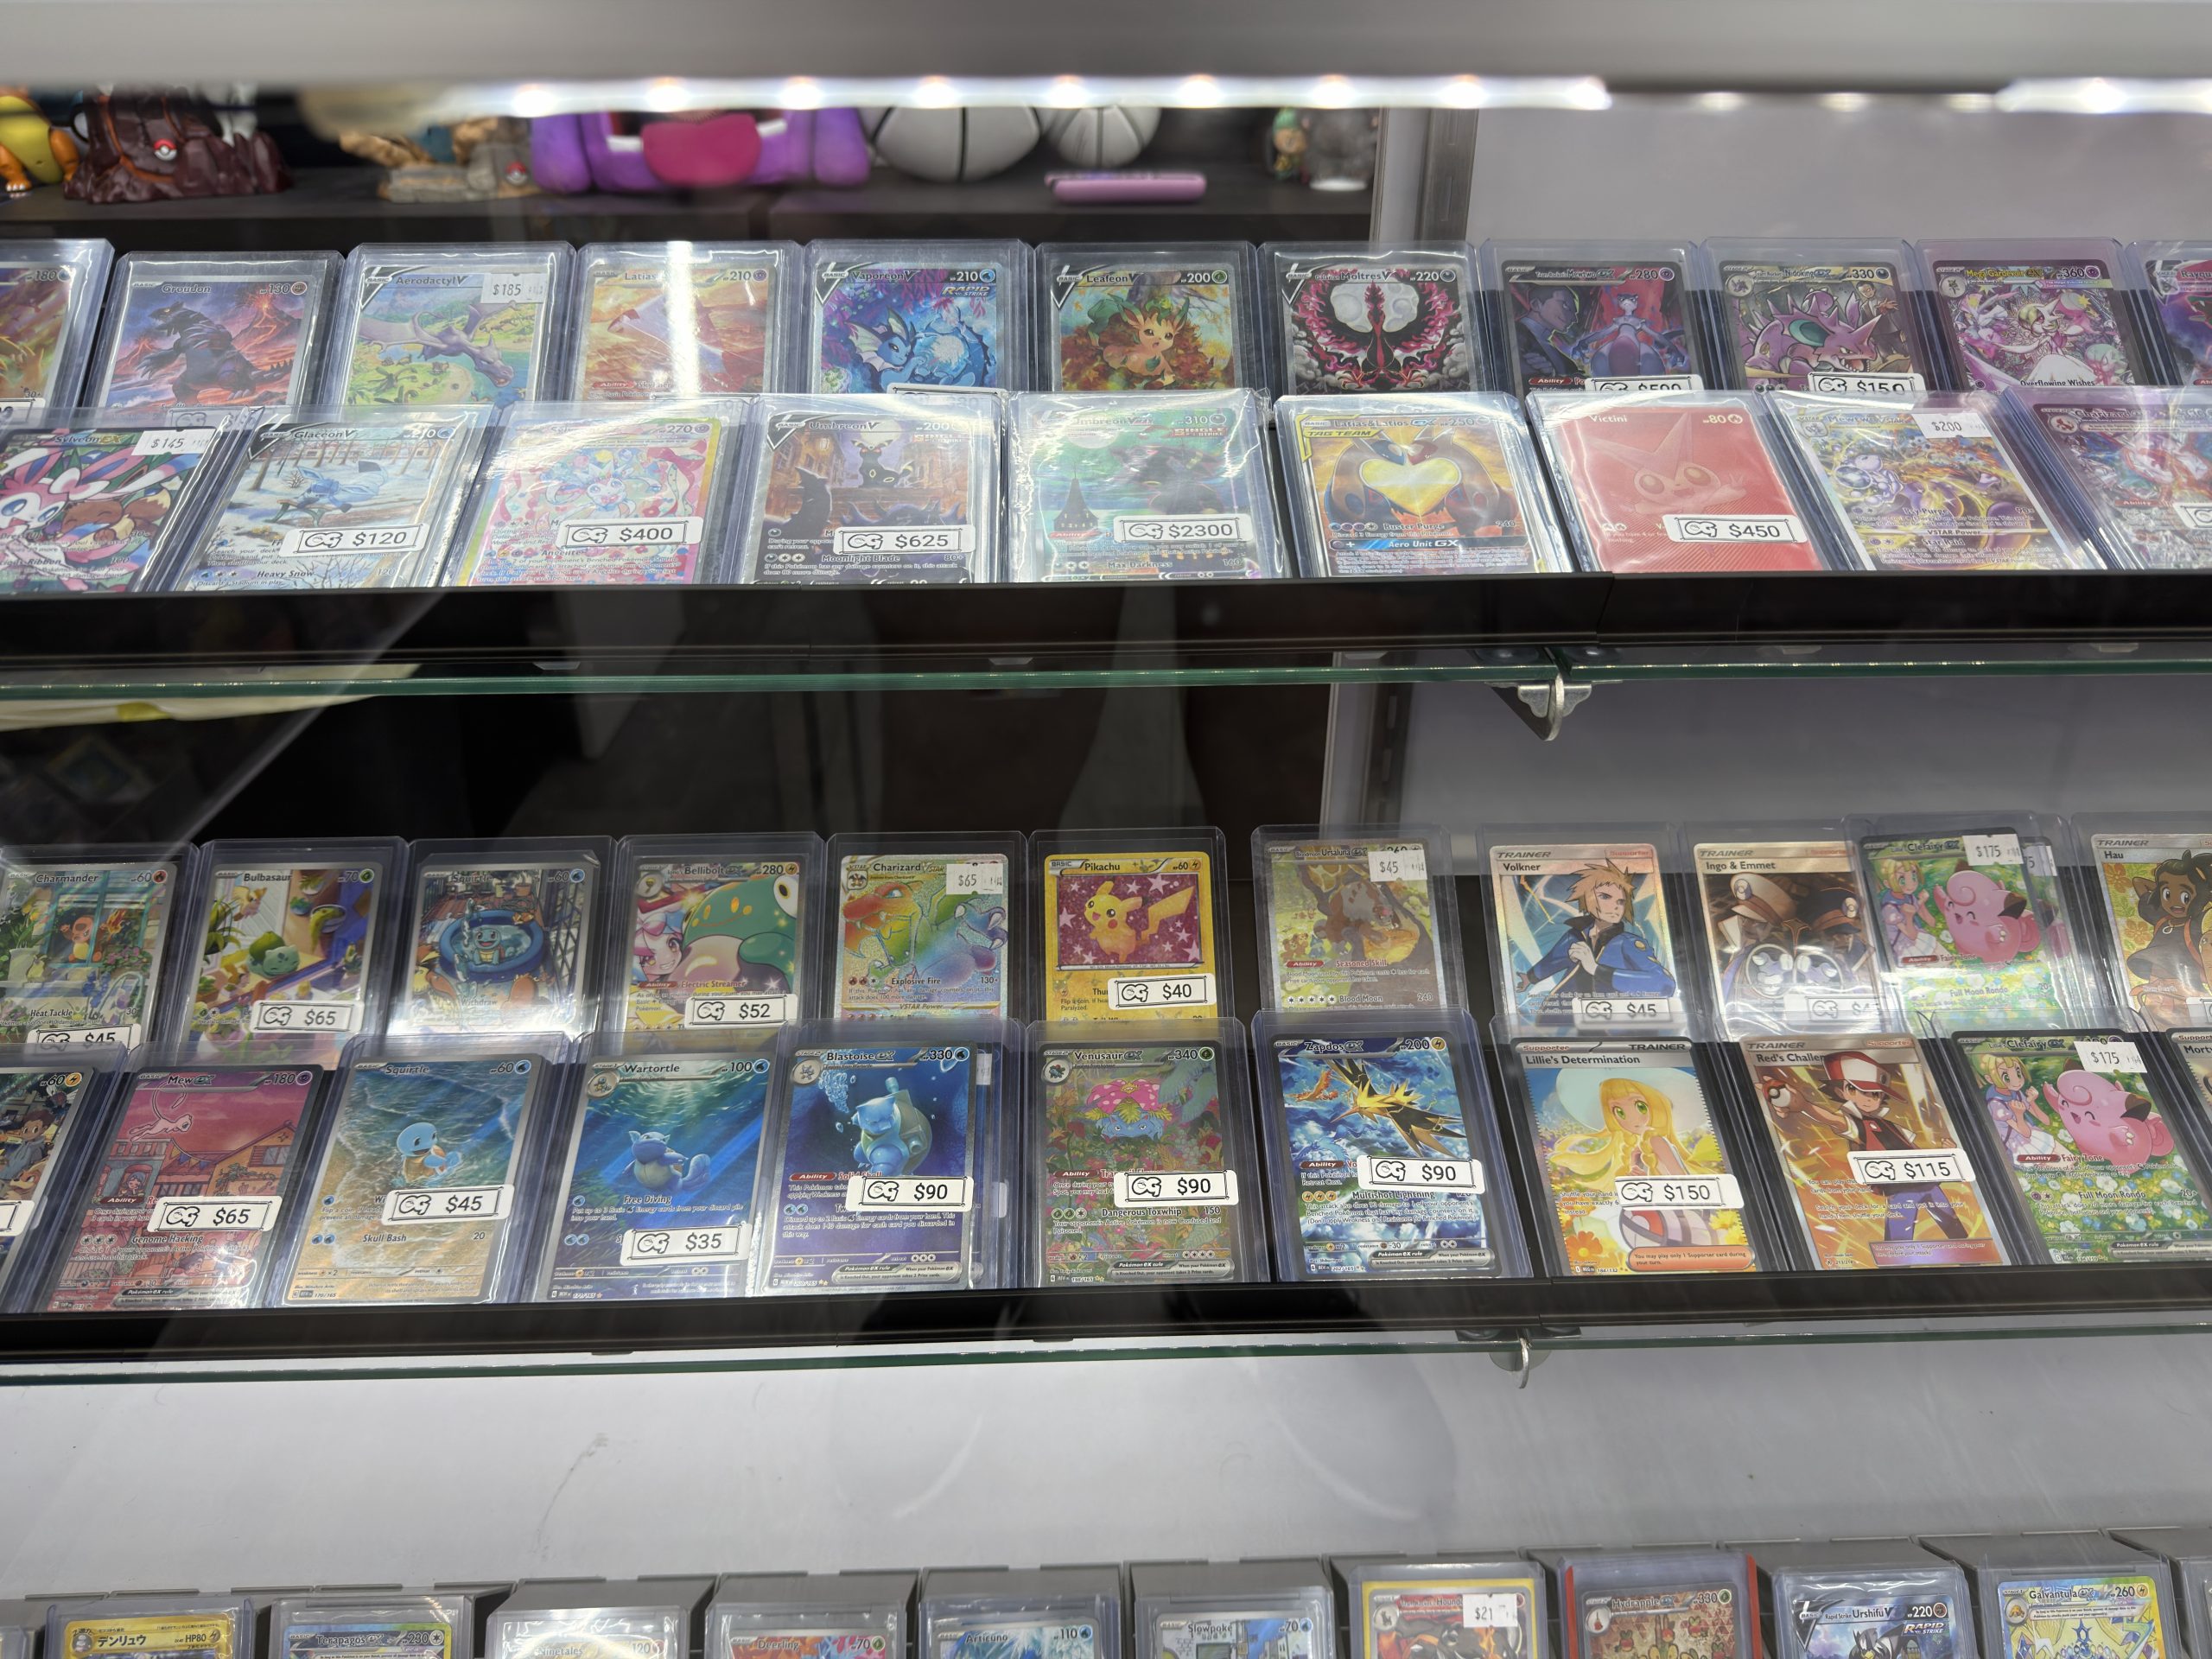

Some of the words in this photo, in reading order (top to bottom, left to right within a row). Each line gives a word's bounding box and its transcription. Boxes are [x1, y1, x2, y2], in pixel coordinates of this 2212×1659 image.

[730, 270, 752, 282] 210
[851, 270, 905, 282] Vaporeon
[957, 271, 978, 282] 210
[1187, 273, 1211, 283] 200
[1340, 271, 1382, 281] Moltres
[1415, 271, 1439, 281] 220
[1637, 270, 1657, 279] 280
[1853, 270, 1874, 279] 330
[2063, 268, 2085, 278] 360
[1086, 274, 1128, 283] Leafeon
[162, 284, 211, 294] Groudon
[269, 283, 290, 294] 130
[493, 283, 522, 296] $185
[1185, 416, 1207, 424] 310
[667, 424, 692, 434] 270
[923, 422, 949, 431] 200
[1931, 422, 1962, 433] $200
[150, 437, 184, 448] $145
[1169, 524, 1233, 538] $2300
[1417, 523, 1445, 531] Purge
[1729, 523, 1780, 538] $450
[353, 532, 407, 547] $120
[619, 527, 673, 542] $400
[895, 534, 949, 549] $625
[822, 554, 871, 563] Moonlight
[1321, 849, 1351, 857] Ursaluna
[1976, 846, 2001, 858] $175
[684, 866, 724, 875] Bellibolt
[763, 865, 783, 874] 280
[873, 863, 921, 872] Charizard
[1084, 862, 1120, 872] Pikachu
[1379, 861, 1399, 874] $45
[1707, 861, 1727, 872] Ingo
[1730, 861, 1738, 870] &
[35, 874, 99, 883] Charmander
[137, 873, 151, 882] 60
[244, 874, 292, 882] Bulbasaur
[555, 873, 569, 881] 60
[958, 874, 977, 887] $65
[892, 977, 925, 986] Explosive
[1162, 983, 1192, 1001] $40
[739, 1002, 771, 1019] $52
[1627, 1002, 1656, 1018] $45
[304, 1010, 336, 1026] $65
[1304, 1041, 1344, 1052] Zapdos
[1406, 1039, 1430, 1051] 200
[2006, 1039, 2047, 1050] Clefairy
[826, 1052, 874, 1061] Blastoise
[929, 1050, 953, 1060] 330
[1075, 1052, 1123, 1061] Venusaur
[1175, 1050, 1198, 1059] 340
[1756, 1053, 1785, 1063] Red's
[2090, 1052, 2120, 1065] $175
[1525, 1056, 1559, 1065] Lillie's
[1561, 1056, 1641, 1065] Determination
[385, 1065, 429, 1075] Squirtle
[498, 1063, 513, 1073] 60
[624, 1064, 680, 1074] Wartortle
[730, 1062, 752, 1073] 100
[48, 1075, 65, 1086] 60
[167, 1075, 194, 1085] Mew
[272, 1073, 296, 1084] 180
[2061, 1154, 2081, 1163] Fairy
[1421, 1164, 1456, 1182] $90
[1904, 1161, 1951, 1179] $115
[913, 1183, 948, 1201] $90
[1177, 1178, 1211, 1196] $90
[1395, 1191, 1434, 1199] Lightning
[1664, 1184, 1710, 1201] $150
[446, 1194, 482, 1214] $45
[623, 1195, 643, 1205] Free
[645, 1195, 672, 1205] Diving
[213, 1208, 251, 1226] $65
[1102, 1209, 1146, 1217] Dangerous
[1147, 1208, 1181, 1217] Toxwhip
[132, 1235, 167, 1244] Genome
[169, 1235, 204, 1244] Hacking
[363, 1234, 385, 1243] Skull
[387, 1234, 407, 1243] Bash
[474, 1231, 486, 1241] 20
[685, 1232, 722, 1251] $35
[2030, 1588, 2078, 1599] Galvantula
[2117, 1586, 2135, 1597] 260
[1699, 1593, 1718, 1604] 330
[1475, 1606, 1493, 1621] $21
[1852, 1610, 1885, 1618] Urshifu
[1912, 1606, 1932, 1618] 220
[1188, 1624, 1232, 1634] Slowpoke
[1285, 1621, 1298, 1631] 70
[1904, 1623, 1944, 1633] RAPID
[408, 1633, 429, 1644] 230
[1059, 1628, 1077, 1639] 110
[97, 1634, 146, 1648] デンリュウ
[317, 1636, 365, 1647] Terapagos
[758, 1640, 799, 1650] Deerling
[857, 1639, 870, 1649] 70
